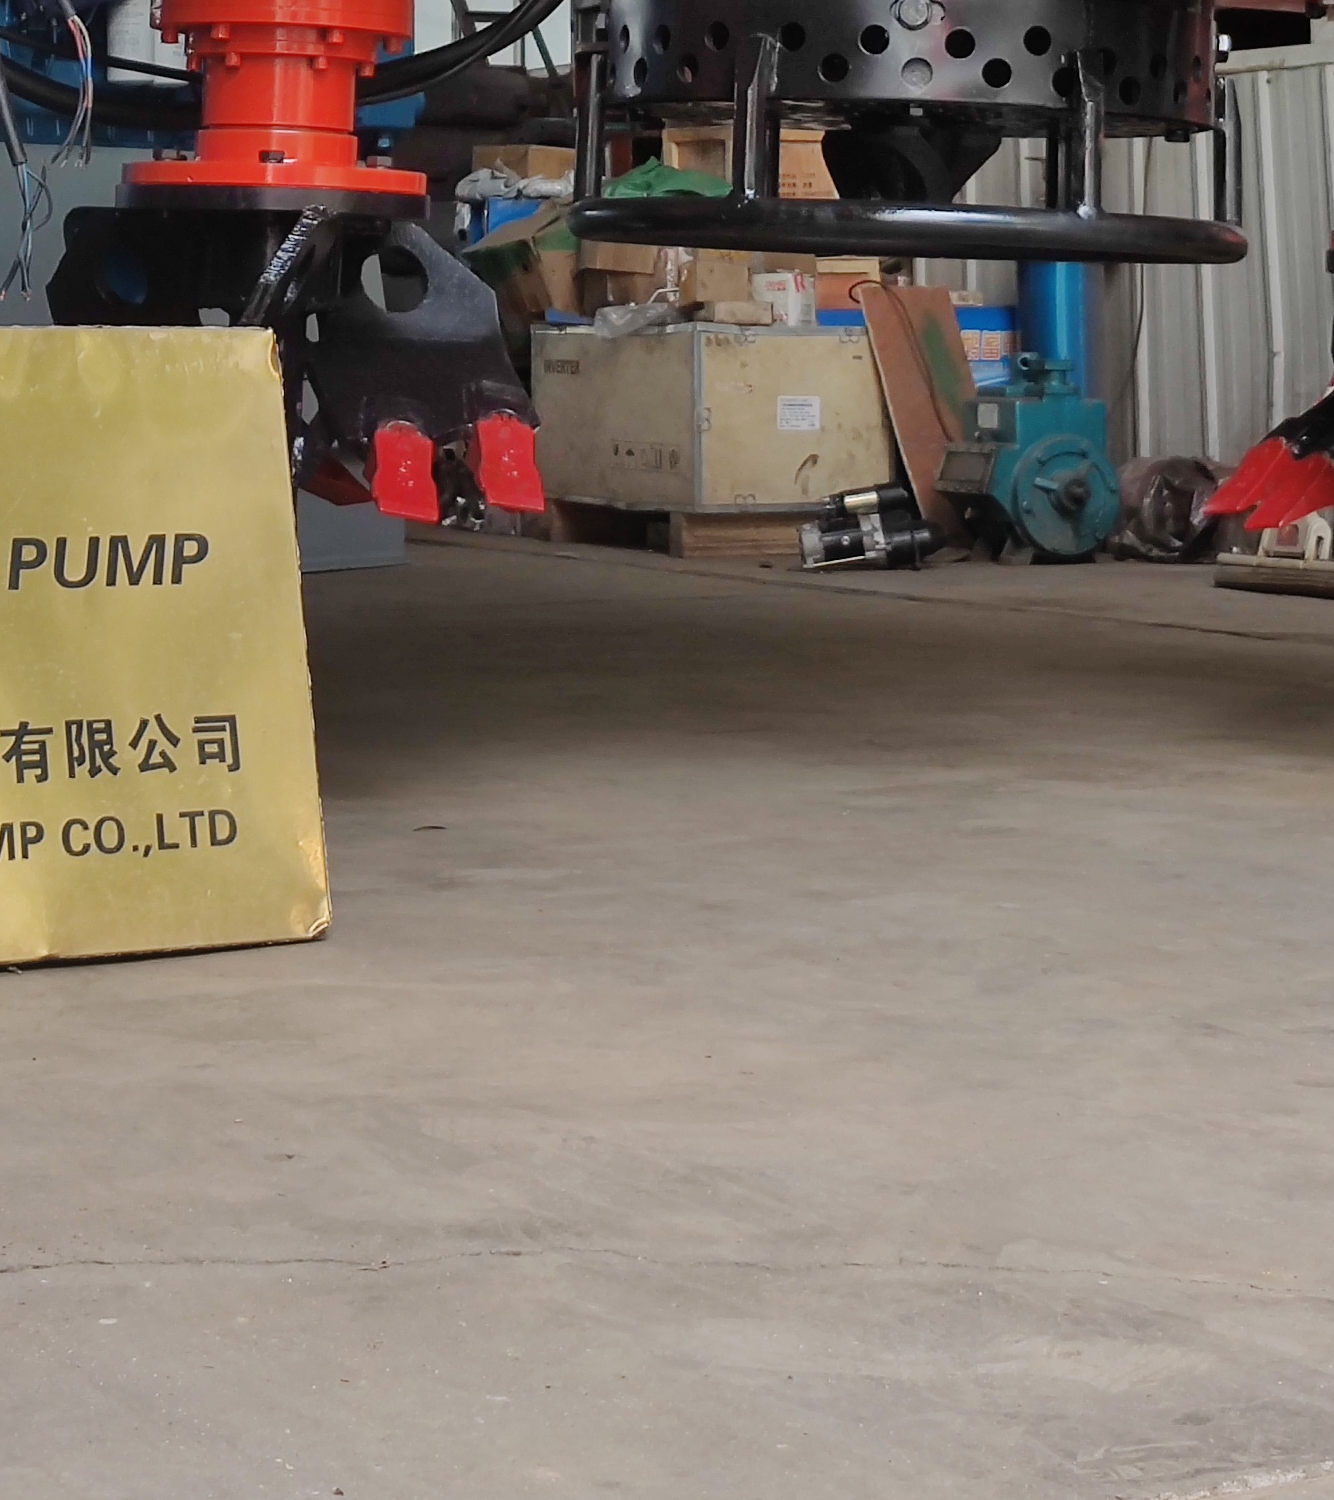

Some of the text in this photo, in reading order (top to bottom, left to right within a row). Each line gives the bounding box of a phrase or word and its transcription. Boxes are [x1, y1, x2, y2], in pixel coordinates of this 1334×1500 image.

[543, 359, 580, 375] INVERTER
[8, 533, 209, 591] PUMP
[61, 809, 238, 858] CO.,LTD
